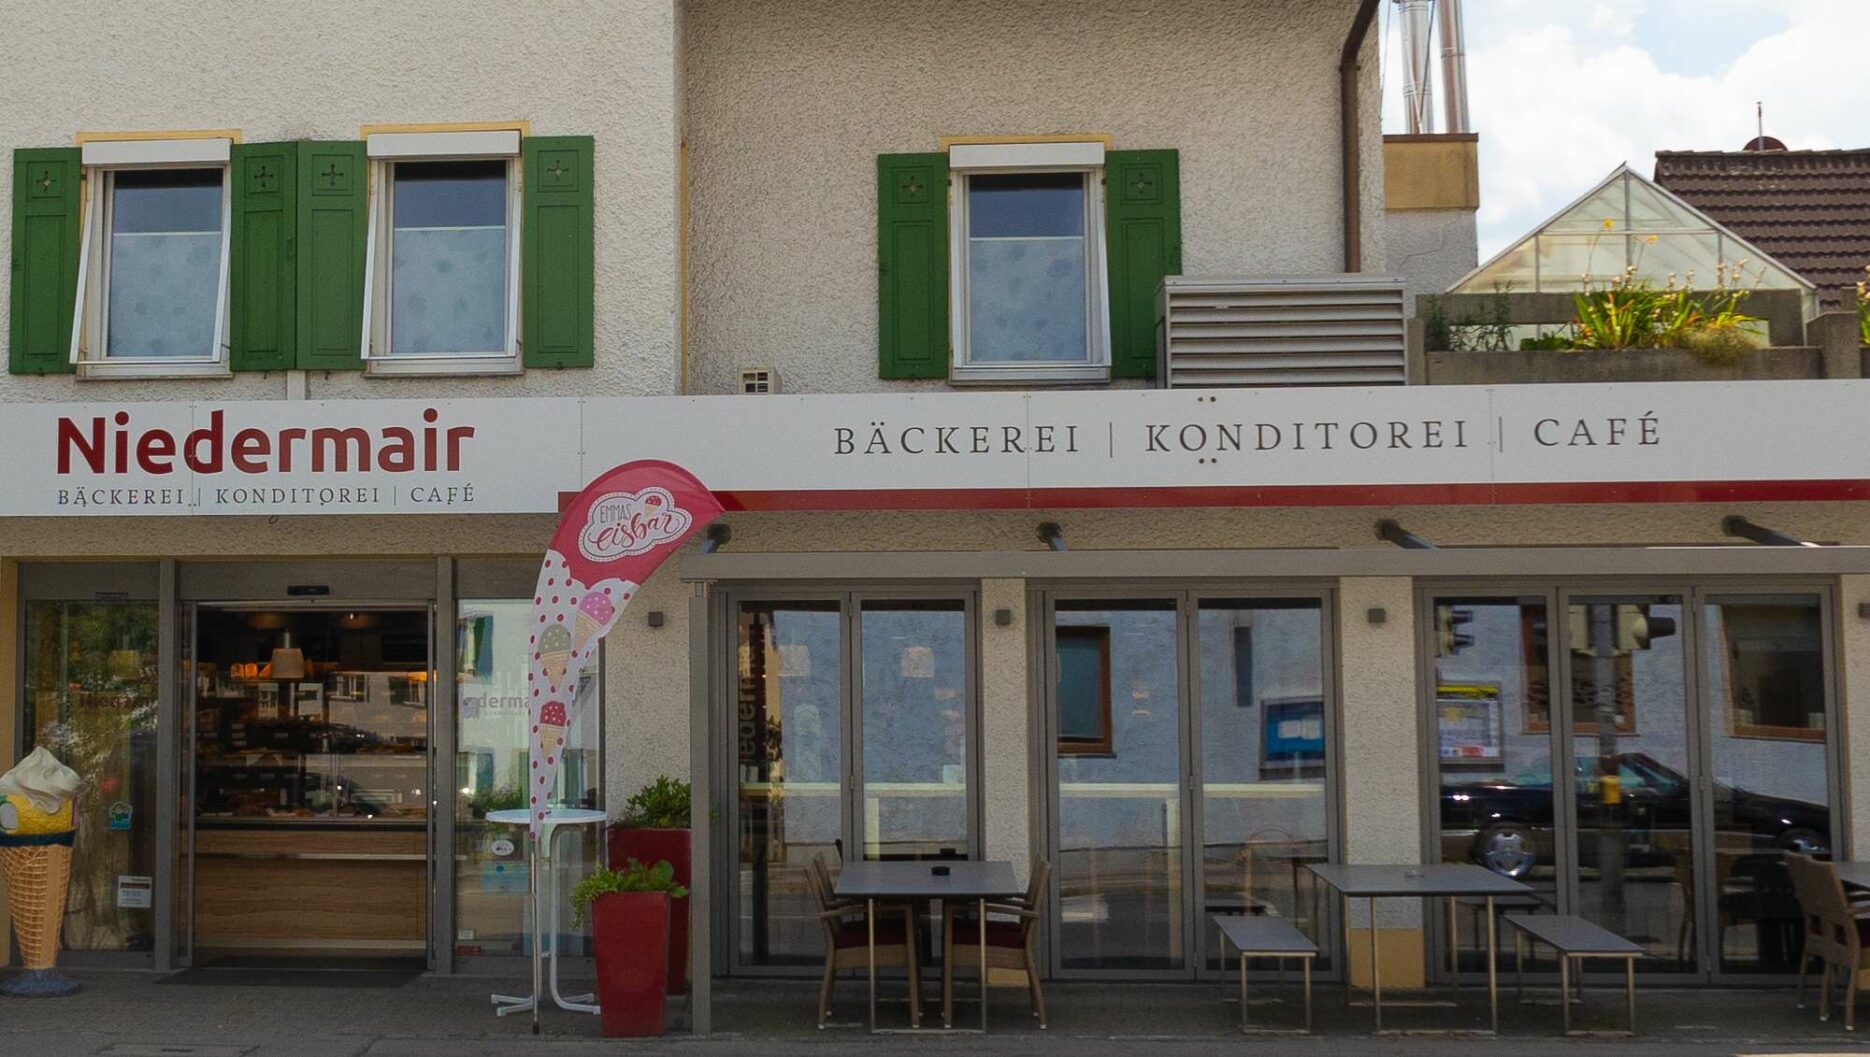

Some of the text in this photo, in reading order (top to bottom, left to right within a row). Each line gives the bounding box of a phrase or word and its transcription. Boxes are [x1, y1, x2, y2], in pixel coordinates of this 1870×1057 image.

[57, 407, 475, 475] Niedermair
[834, 410, 1661, 455] BÄCKEREI KONDITOREI CAFÉ
[58, 483, 475, 505] BÄCKEREI KONDITOREI CAFÉ
[600, 503, 632, 523] EMMAS
